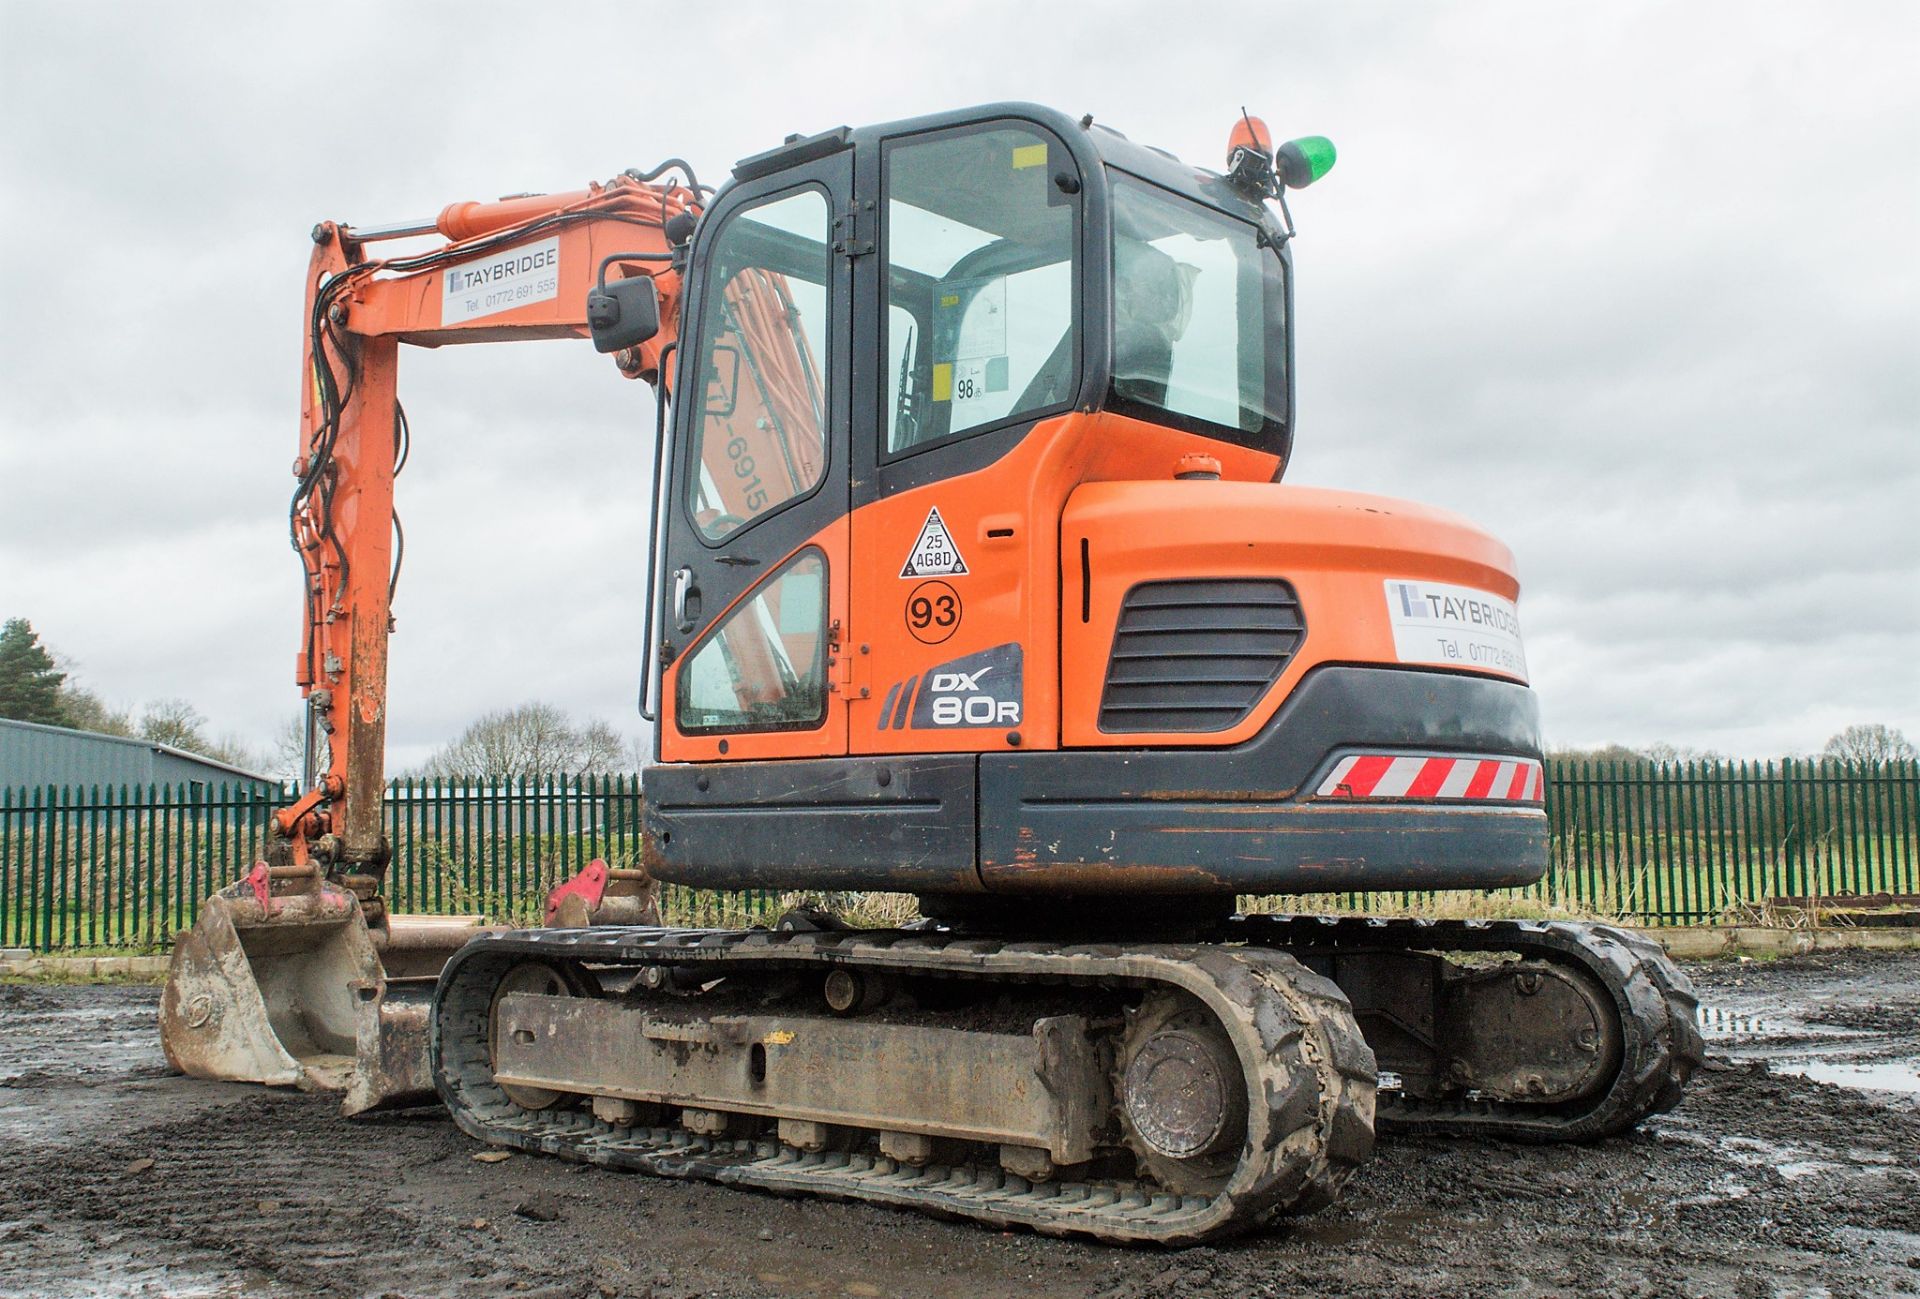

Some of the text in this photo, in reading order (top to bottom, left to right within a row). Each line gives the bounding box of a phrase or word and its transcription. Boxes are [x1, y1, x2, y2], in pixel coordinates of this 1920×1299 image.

[465, 248, 556, 288] TAYBRIDGE
[485, 289, 514, 307] 01772
[516, 284, 533, 299] 691
[537, 278, 556, 293] 555
[958, 378, 974, 399] 98
[926, 534, 943, 550] 25
[916, 551, 952, 567] AG8D
[911, 595, 956, 629] 93
[1438, 638, 1462, 659] Tel.
[1469, 642, 1501, 665] 01772
[931, 666, 993, 692] DX
[932, 696, 1020, 725] 80R
